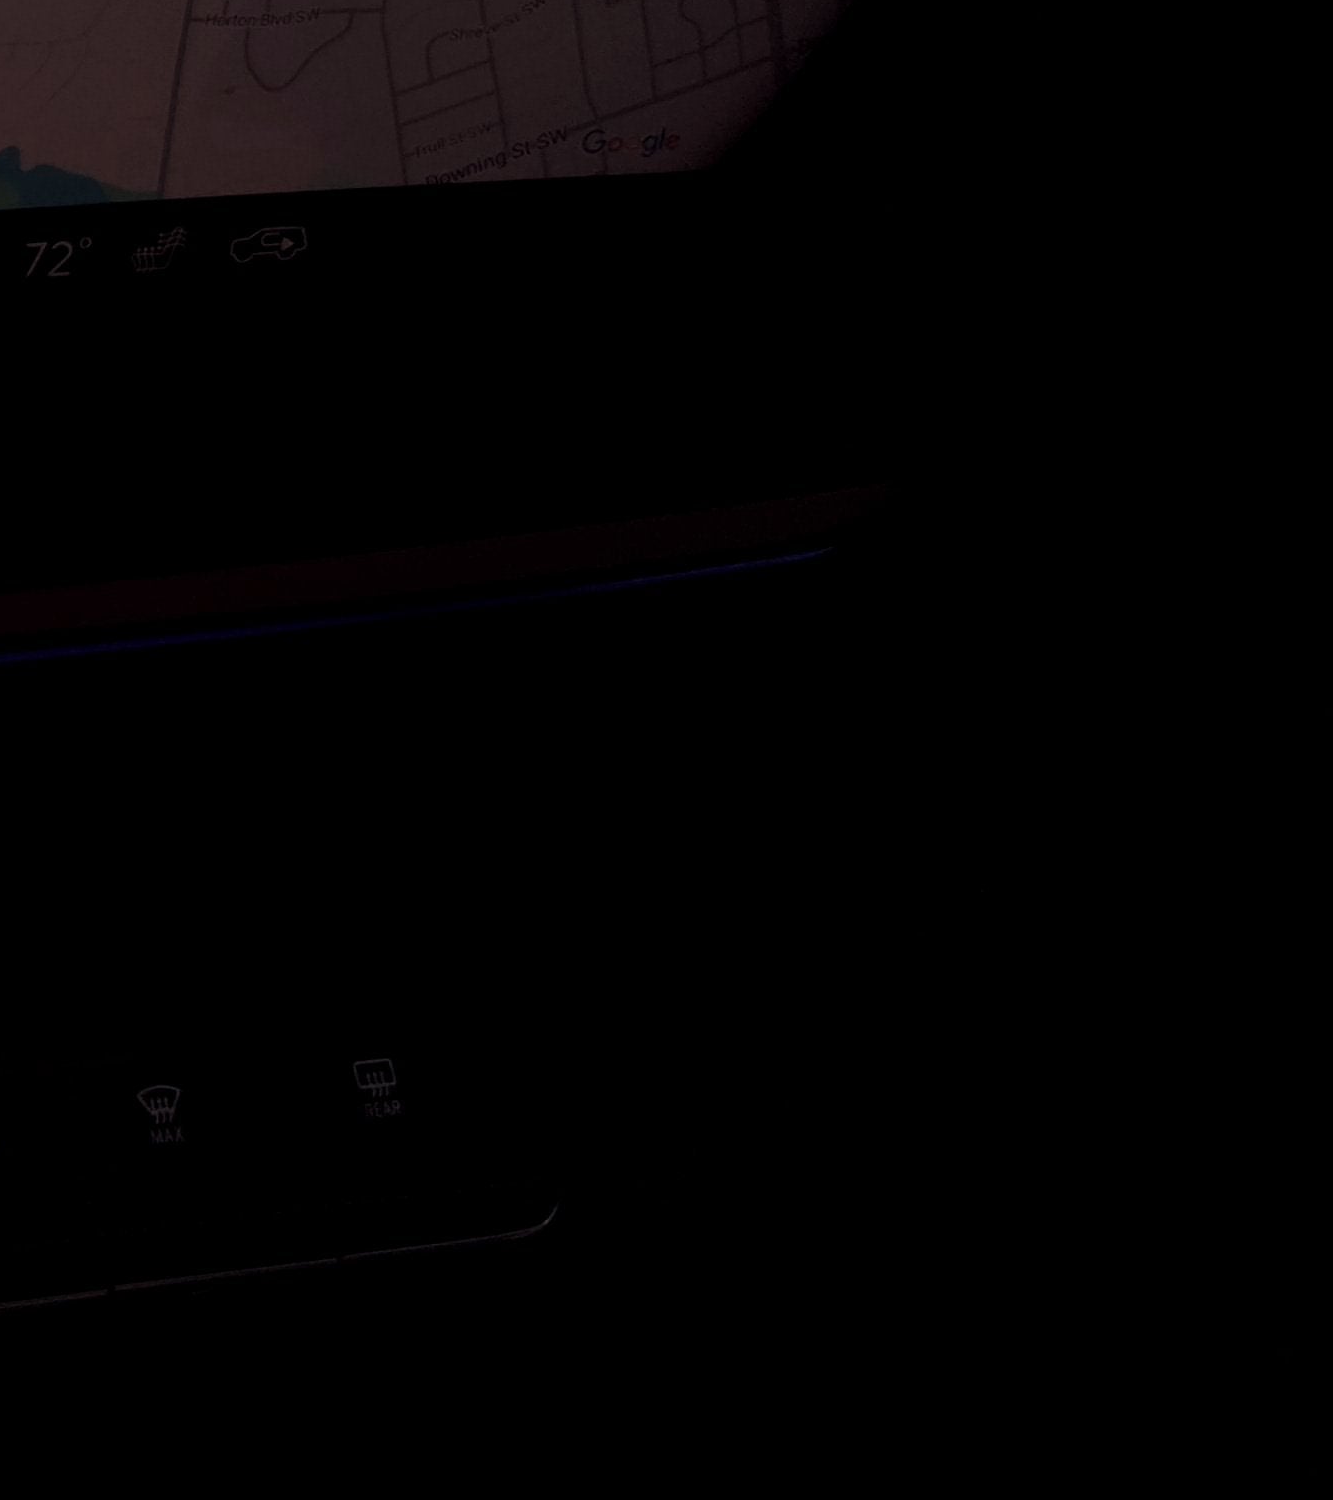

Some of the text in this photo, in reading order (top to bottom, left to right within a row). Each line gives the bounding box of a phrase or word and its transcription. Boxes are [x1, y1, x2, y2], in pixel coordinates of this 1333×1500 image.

[512, 140, 531, 159] St
[535, 125, 568, 151] SW
[25, 236, 93, 277] 72°
